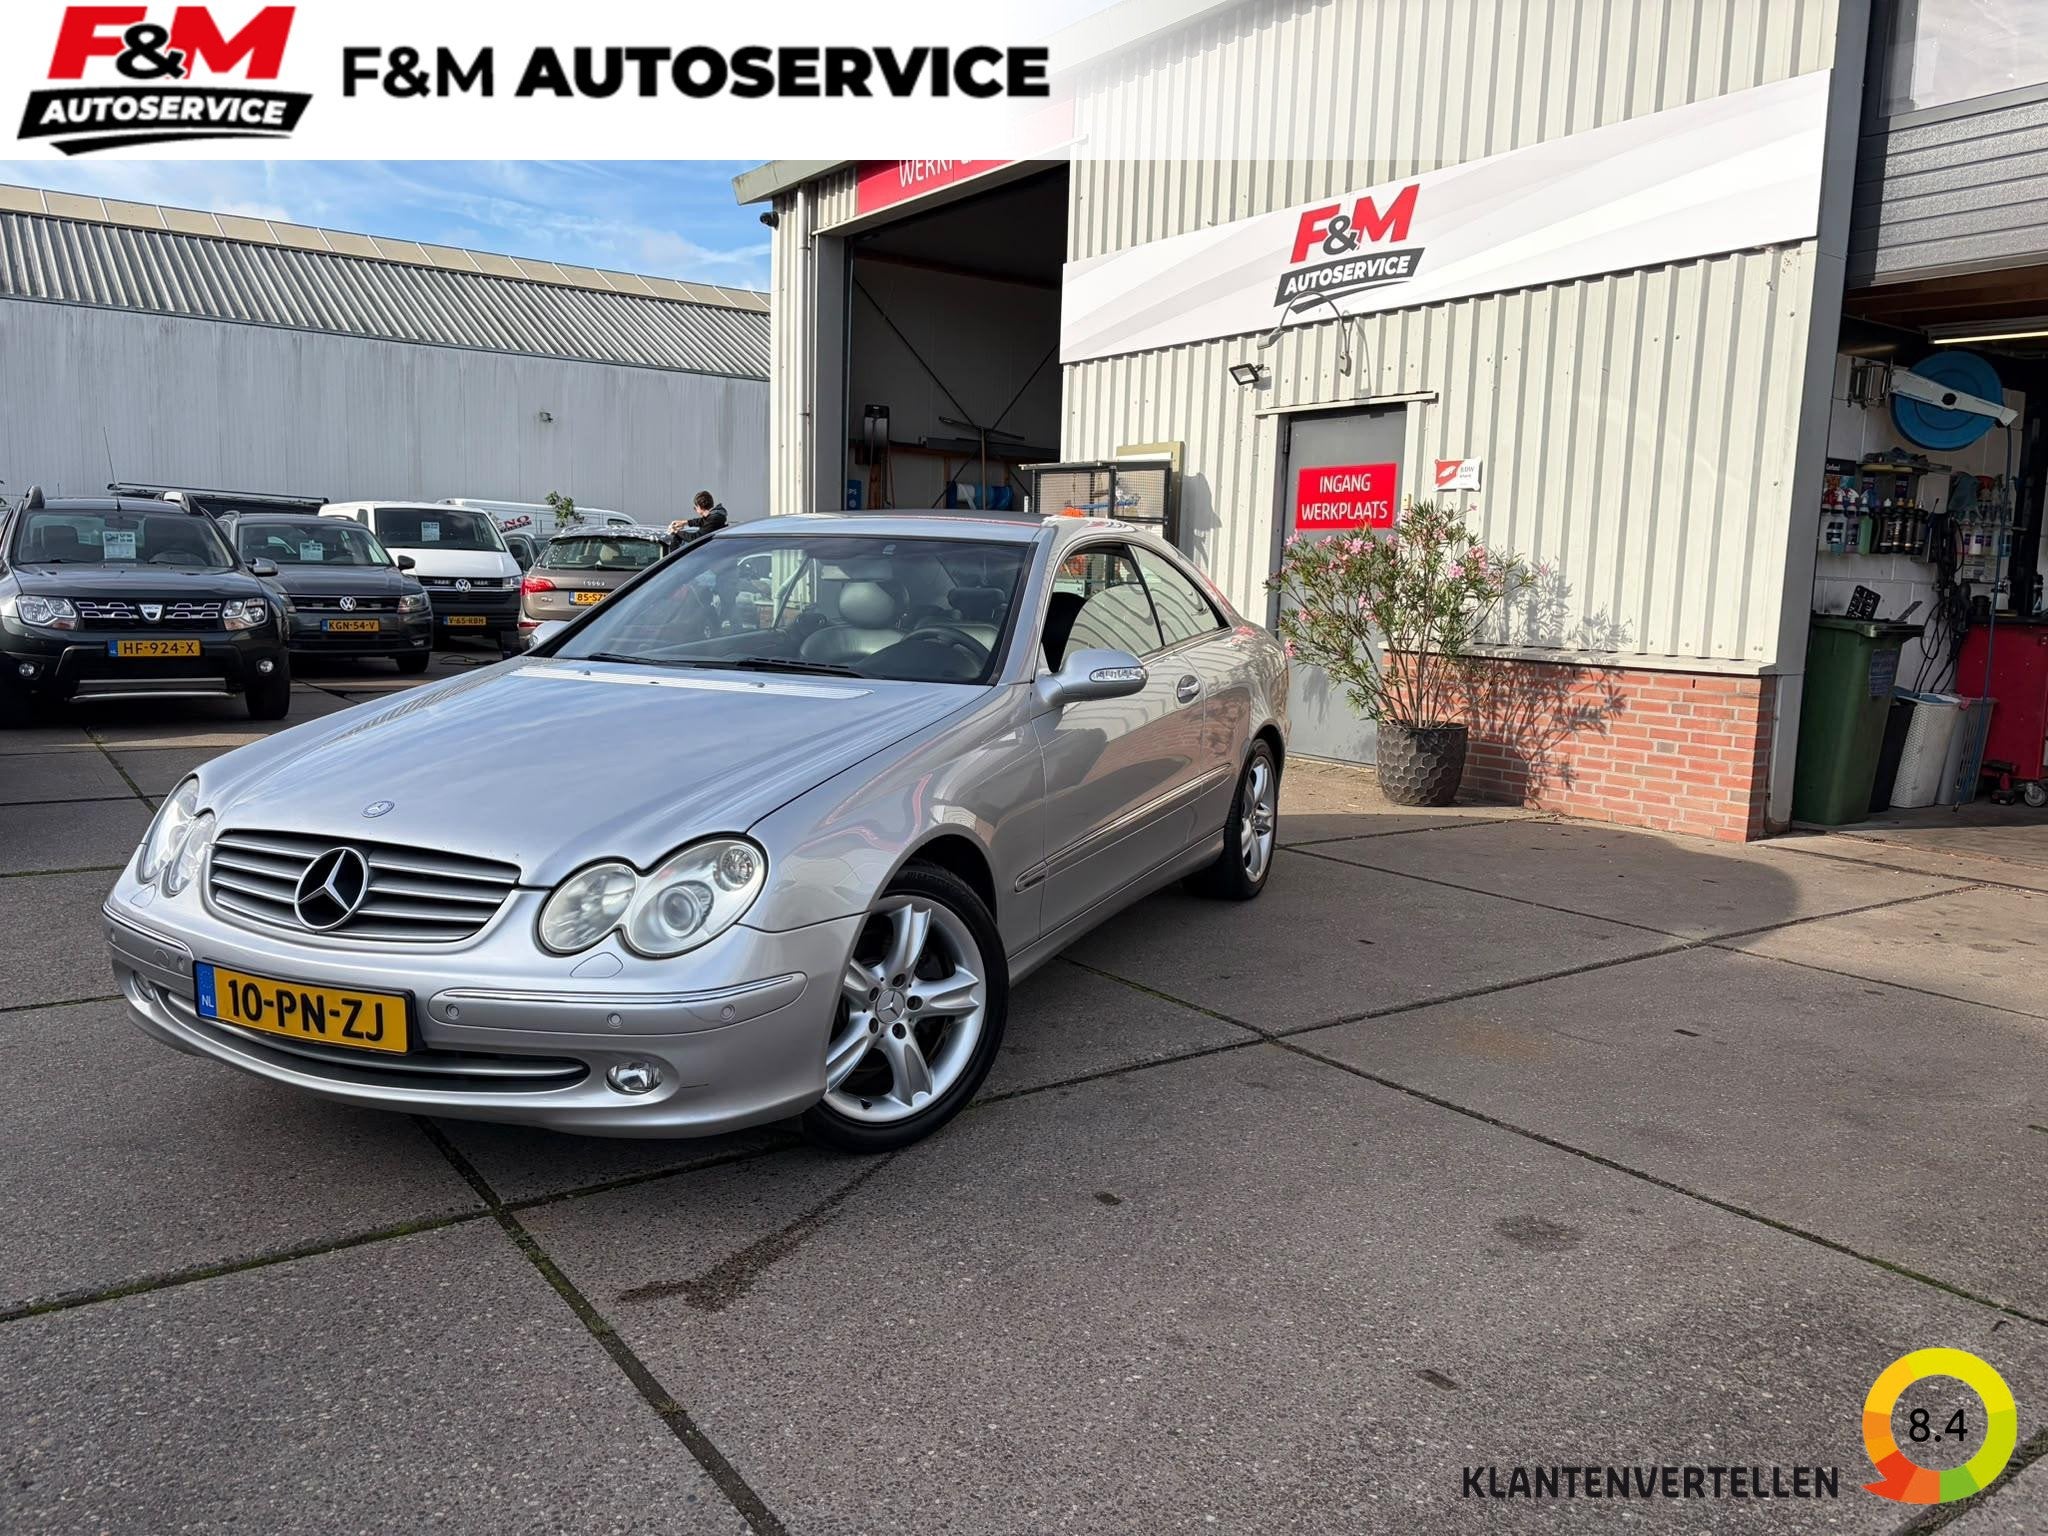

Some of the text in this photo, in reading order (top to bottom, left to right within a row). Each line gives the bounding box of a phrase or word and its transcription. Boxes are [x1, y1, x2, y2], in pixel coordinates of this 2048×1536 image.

[1290, 183, 1420, 264] F&M
[1284, 255, 1411, 296] AUTOSERVICE
[1319, 473, 1372, 494] INGANG
[1301, 500, 1388, 521] WERKPLAATS
[576, 593, 606, 602] 85-SZ
[328, 621, 375, 630] KGN-54-V
[123, 642, 195, 655] HF-924-X
[201, 979, 384, 1042] NL 10-PN-ZJ
